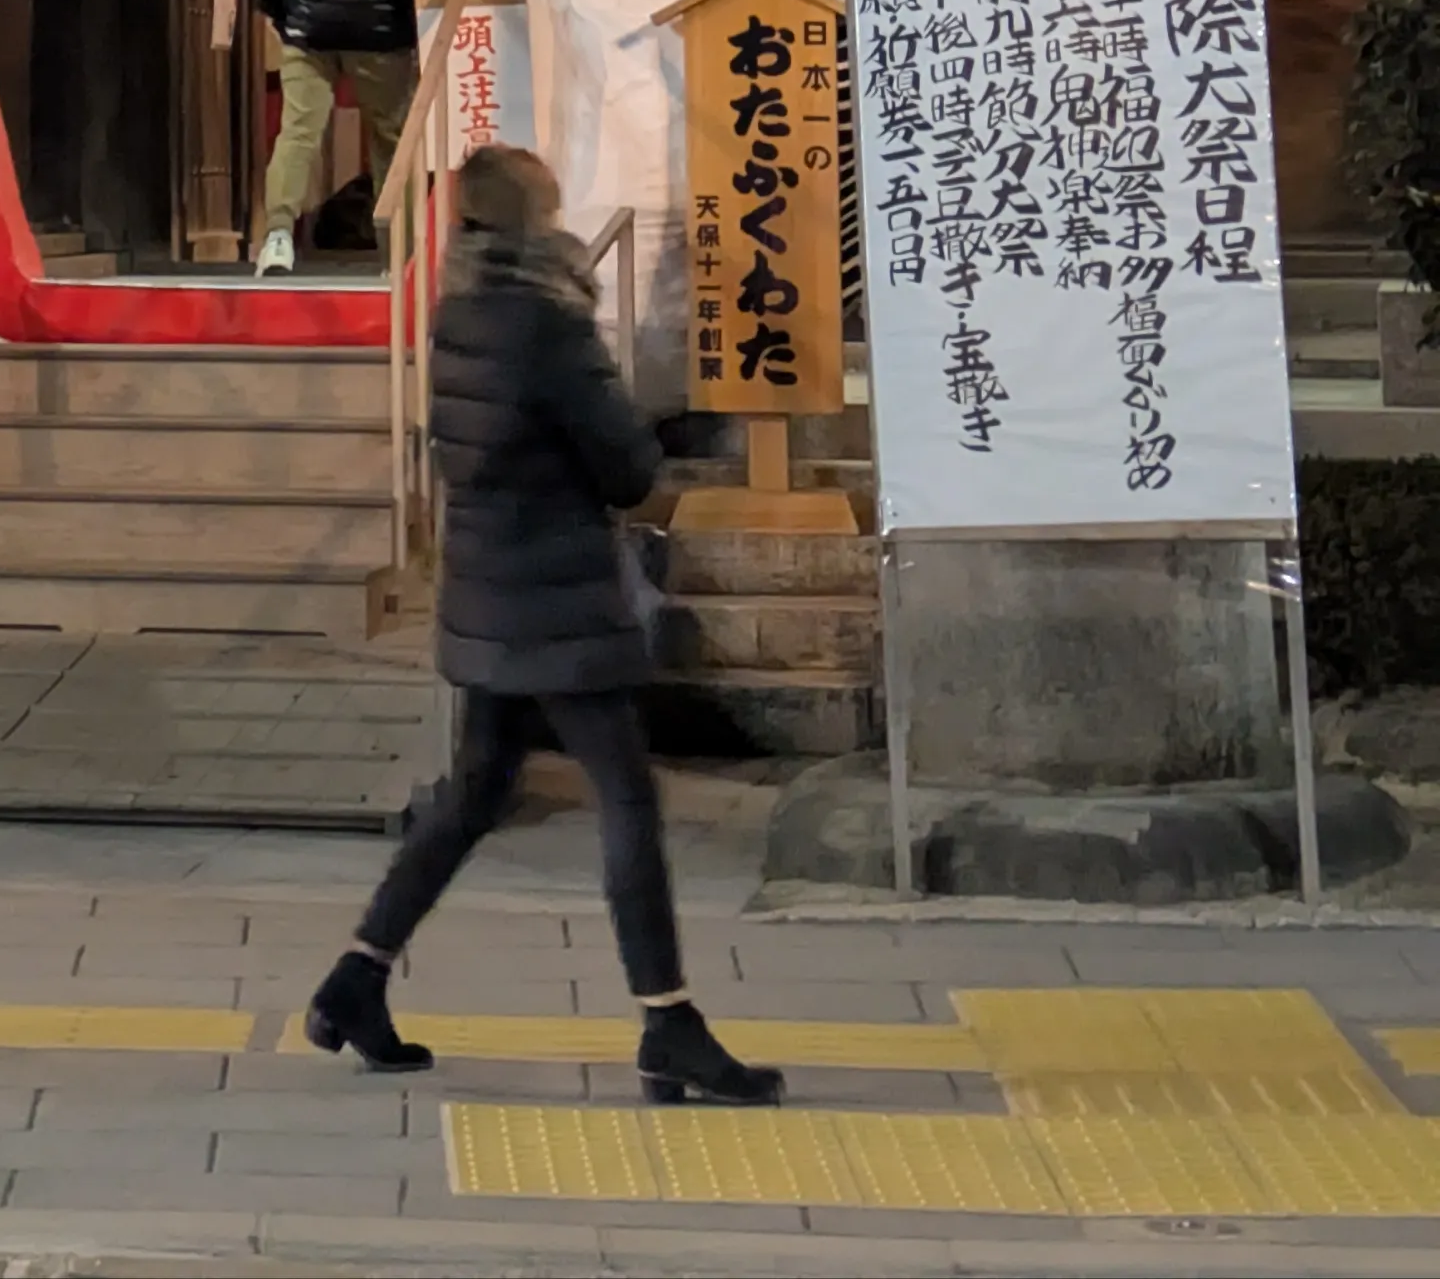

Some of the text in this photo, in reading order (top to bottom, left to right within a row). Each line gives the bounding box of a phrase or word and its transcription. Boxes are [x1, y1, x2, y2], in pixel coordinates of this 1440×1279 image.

[801, 20, 832, 171] 日本一の
[695, 195, 724, 381] 天保十一年創業
[727, 14, 800, 387] おたふくわた
